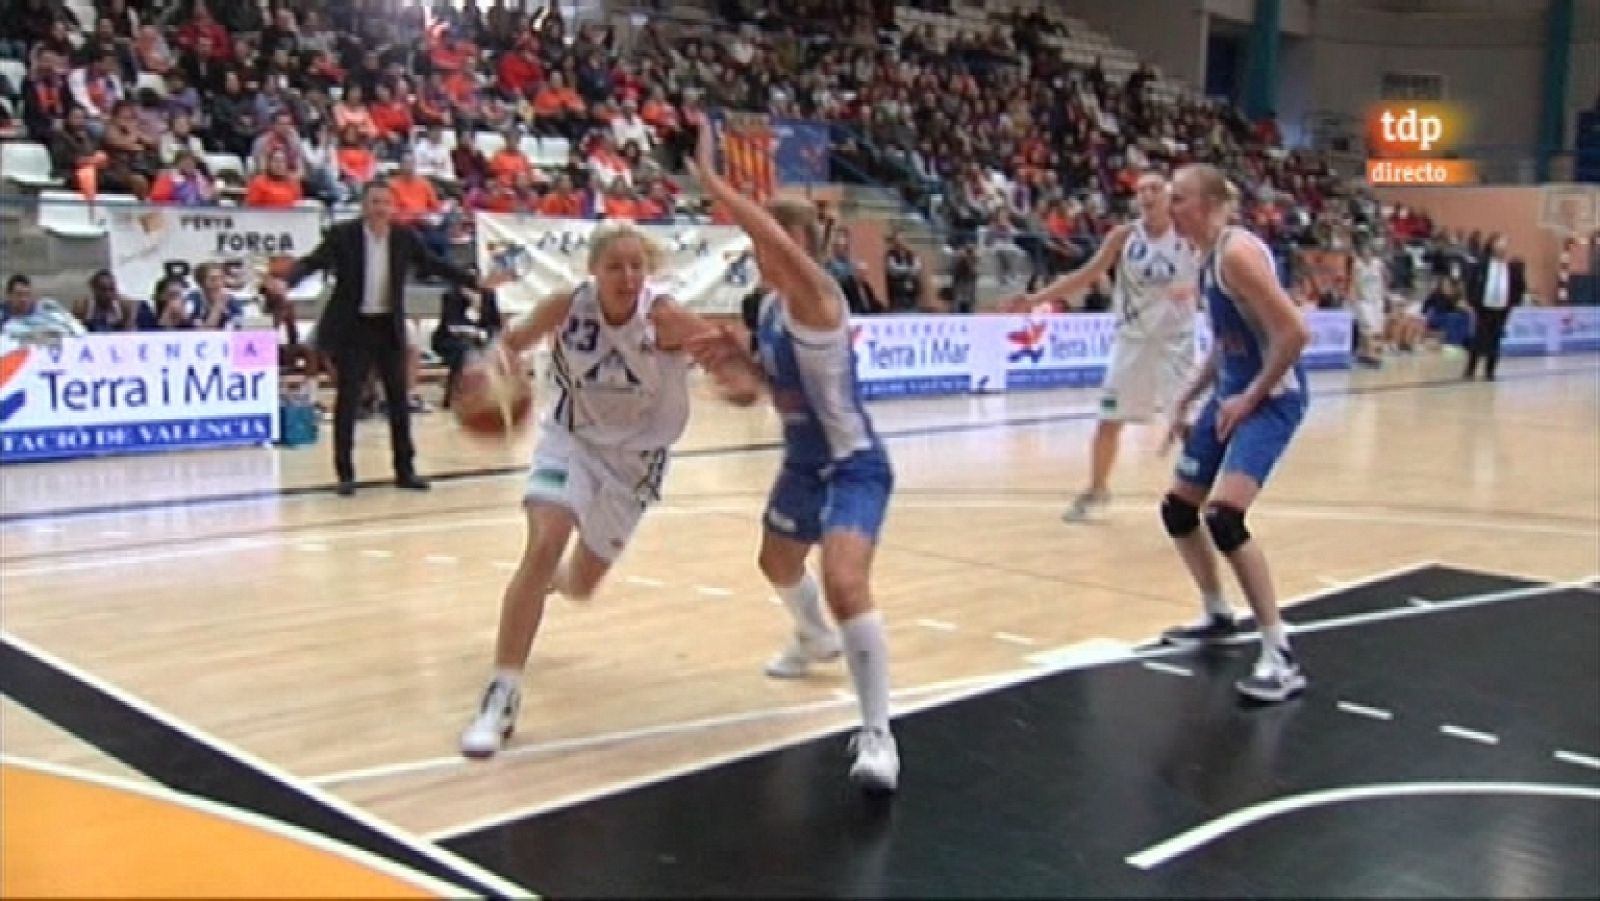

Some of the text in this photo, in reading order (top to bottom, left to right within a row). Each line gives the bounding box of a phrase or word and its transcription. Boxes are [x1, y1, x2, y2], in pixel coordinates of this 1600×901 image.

[47, 340, 258, 363] VALENCIA
[865, 340, 916, 370] Terra
[930, 337, 970, 364] Mar
[39, 364, 265, 412] Terra i Mar
